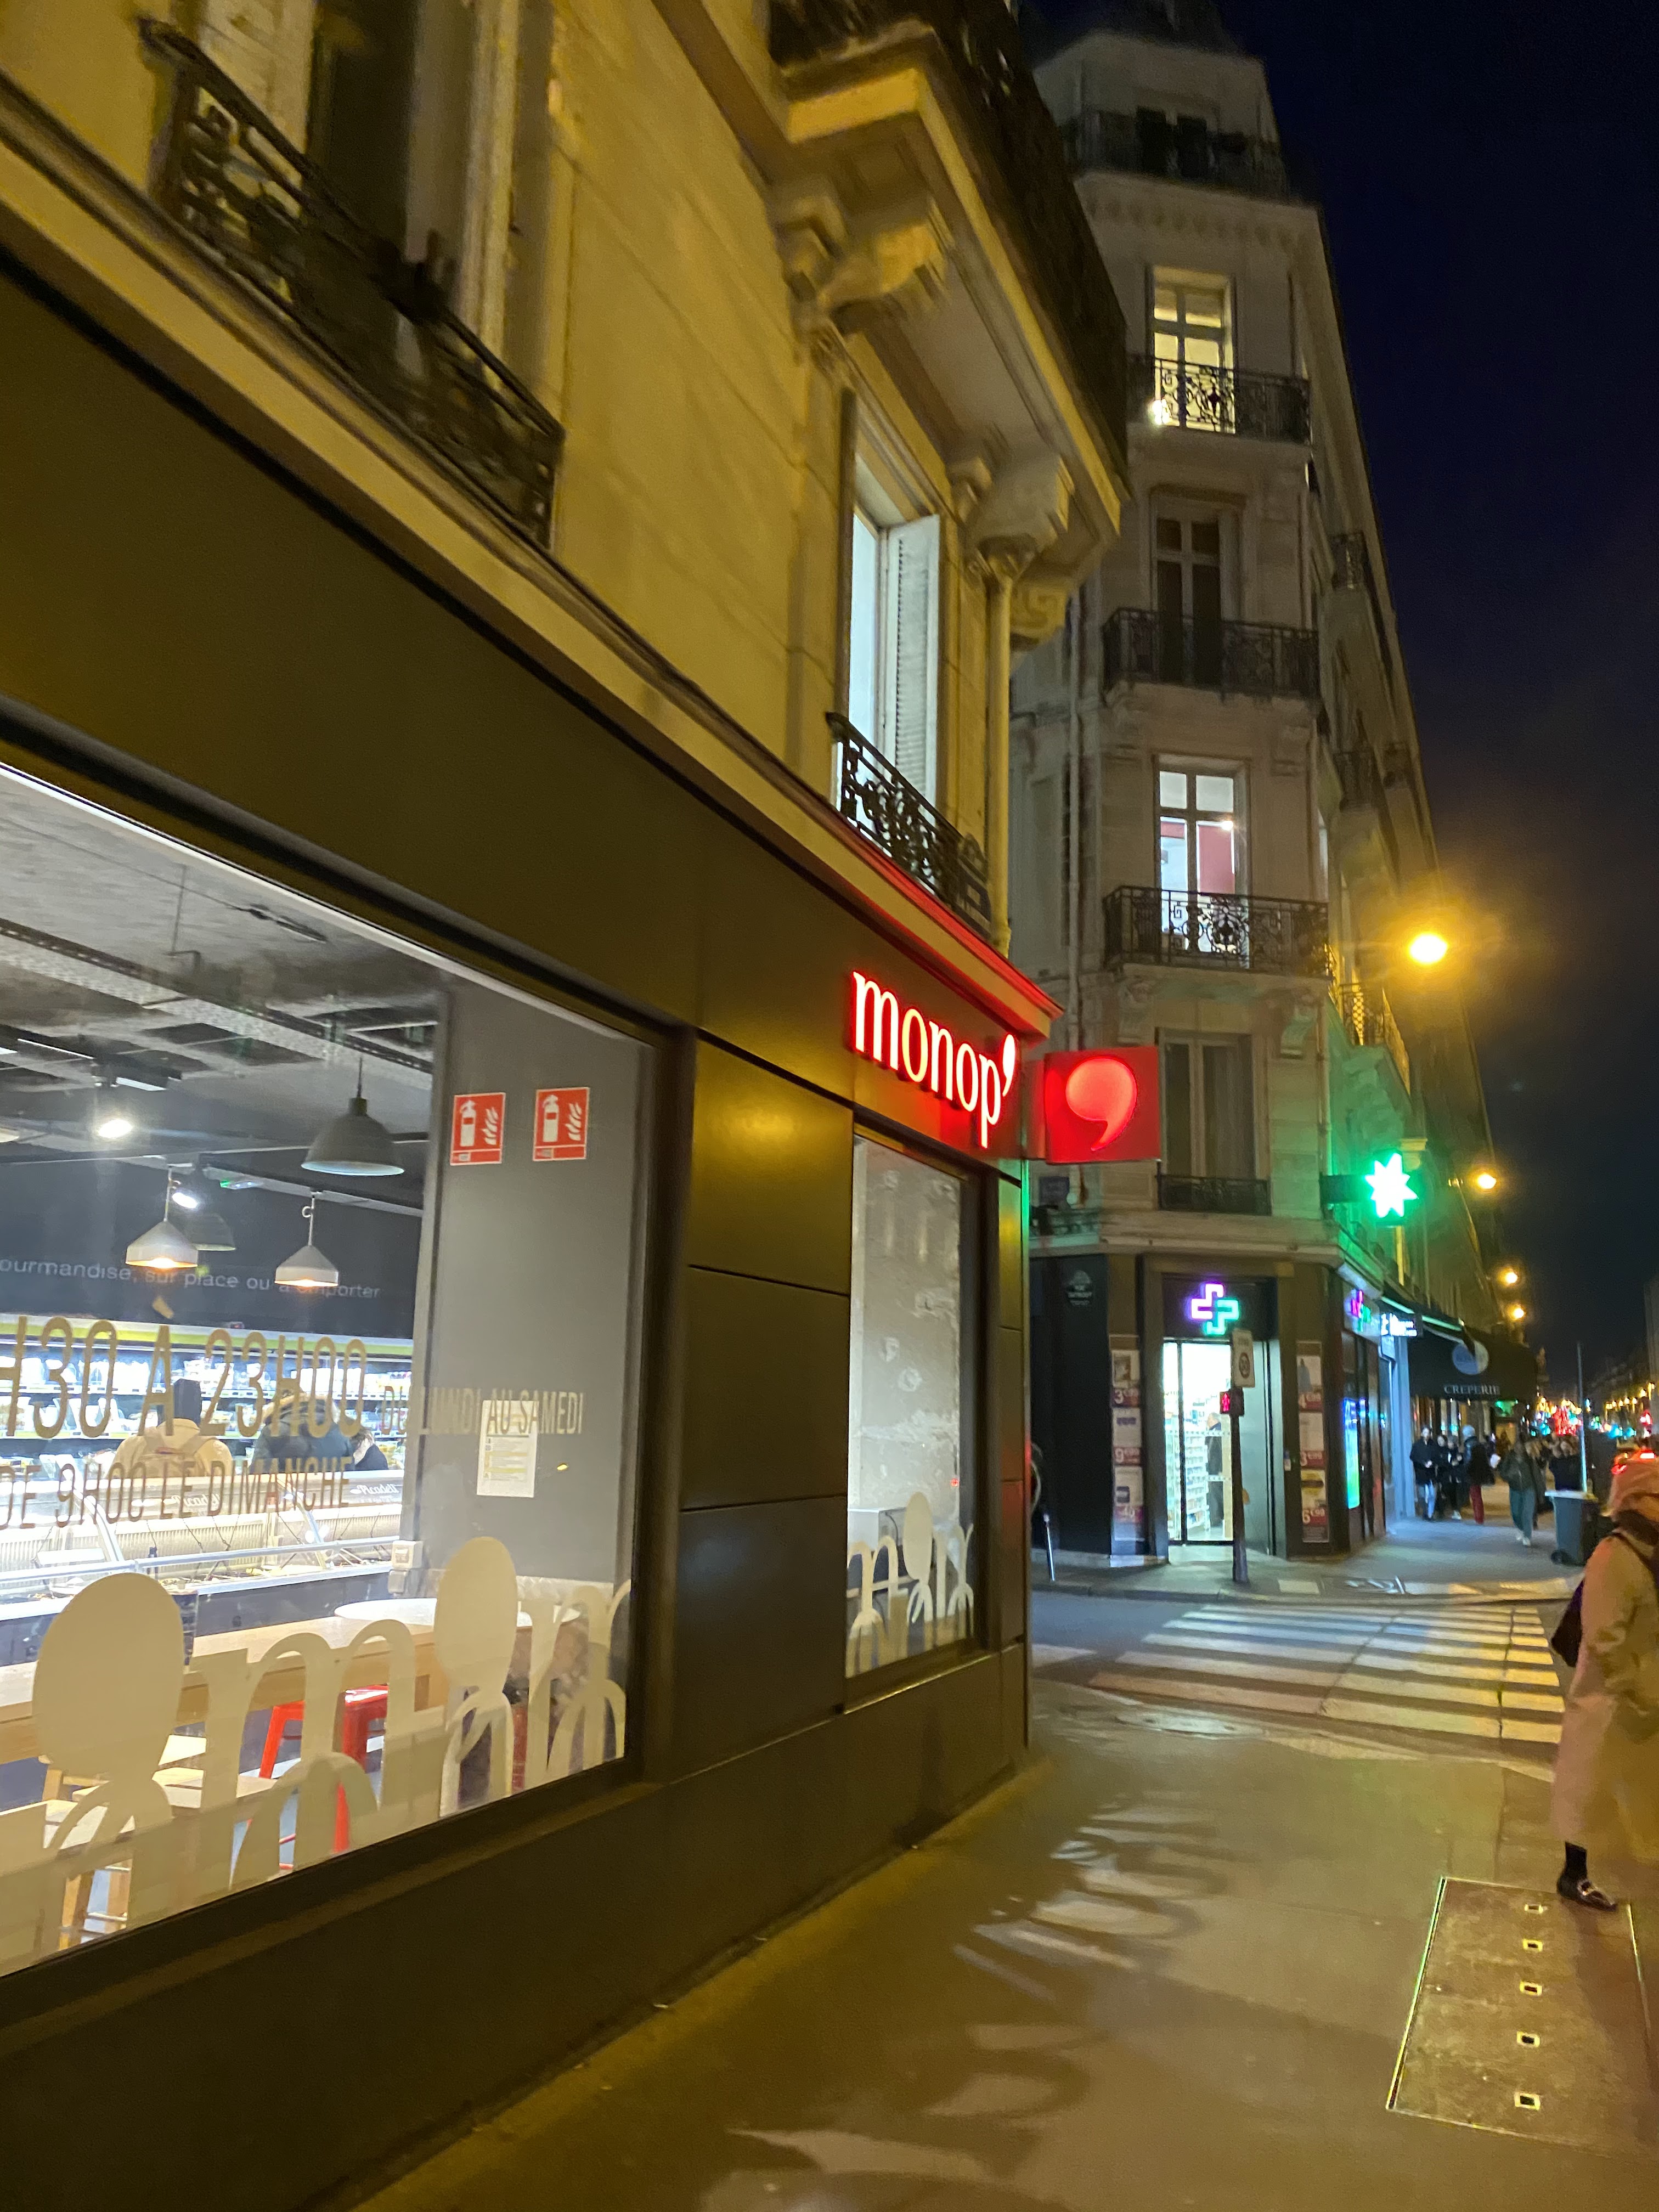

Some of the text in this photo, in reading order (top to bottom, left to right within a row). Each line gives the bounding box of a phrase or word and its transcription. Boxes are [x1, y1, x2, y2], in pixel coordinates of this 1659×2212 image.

[247, 1277, 270, 1290] ou
[198, 1329, 367, 1438] 23H00
[487, 1388, 513, 1435] AU
[518, 1389, 585, 1434] SAMEDI
[55, 1463, 146, 1527] 9H00
[160, 1460, 196, 1519] LE
[207, 1456, 353, 1516] DIMANCHE
